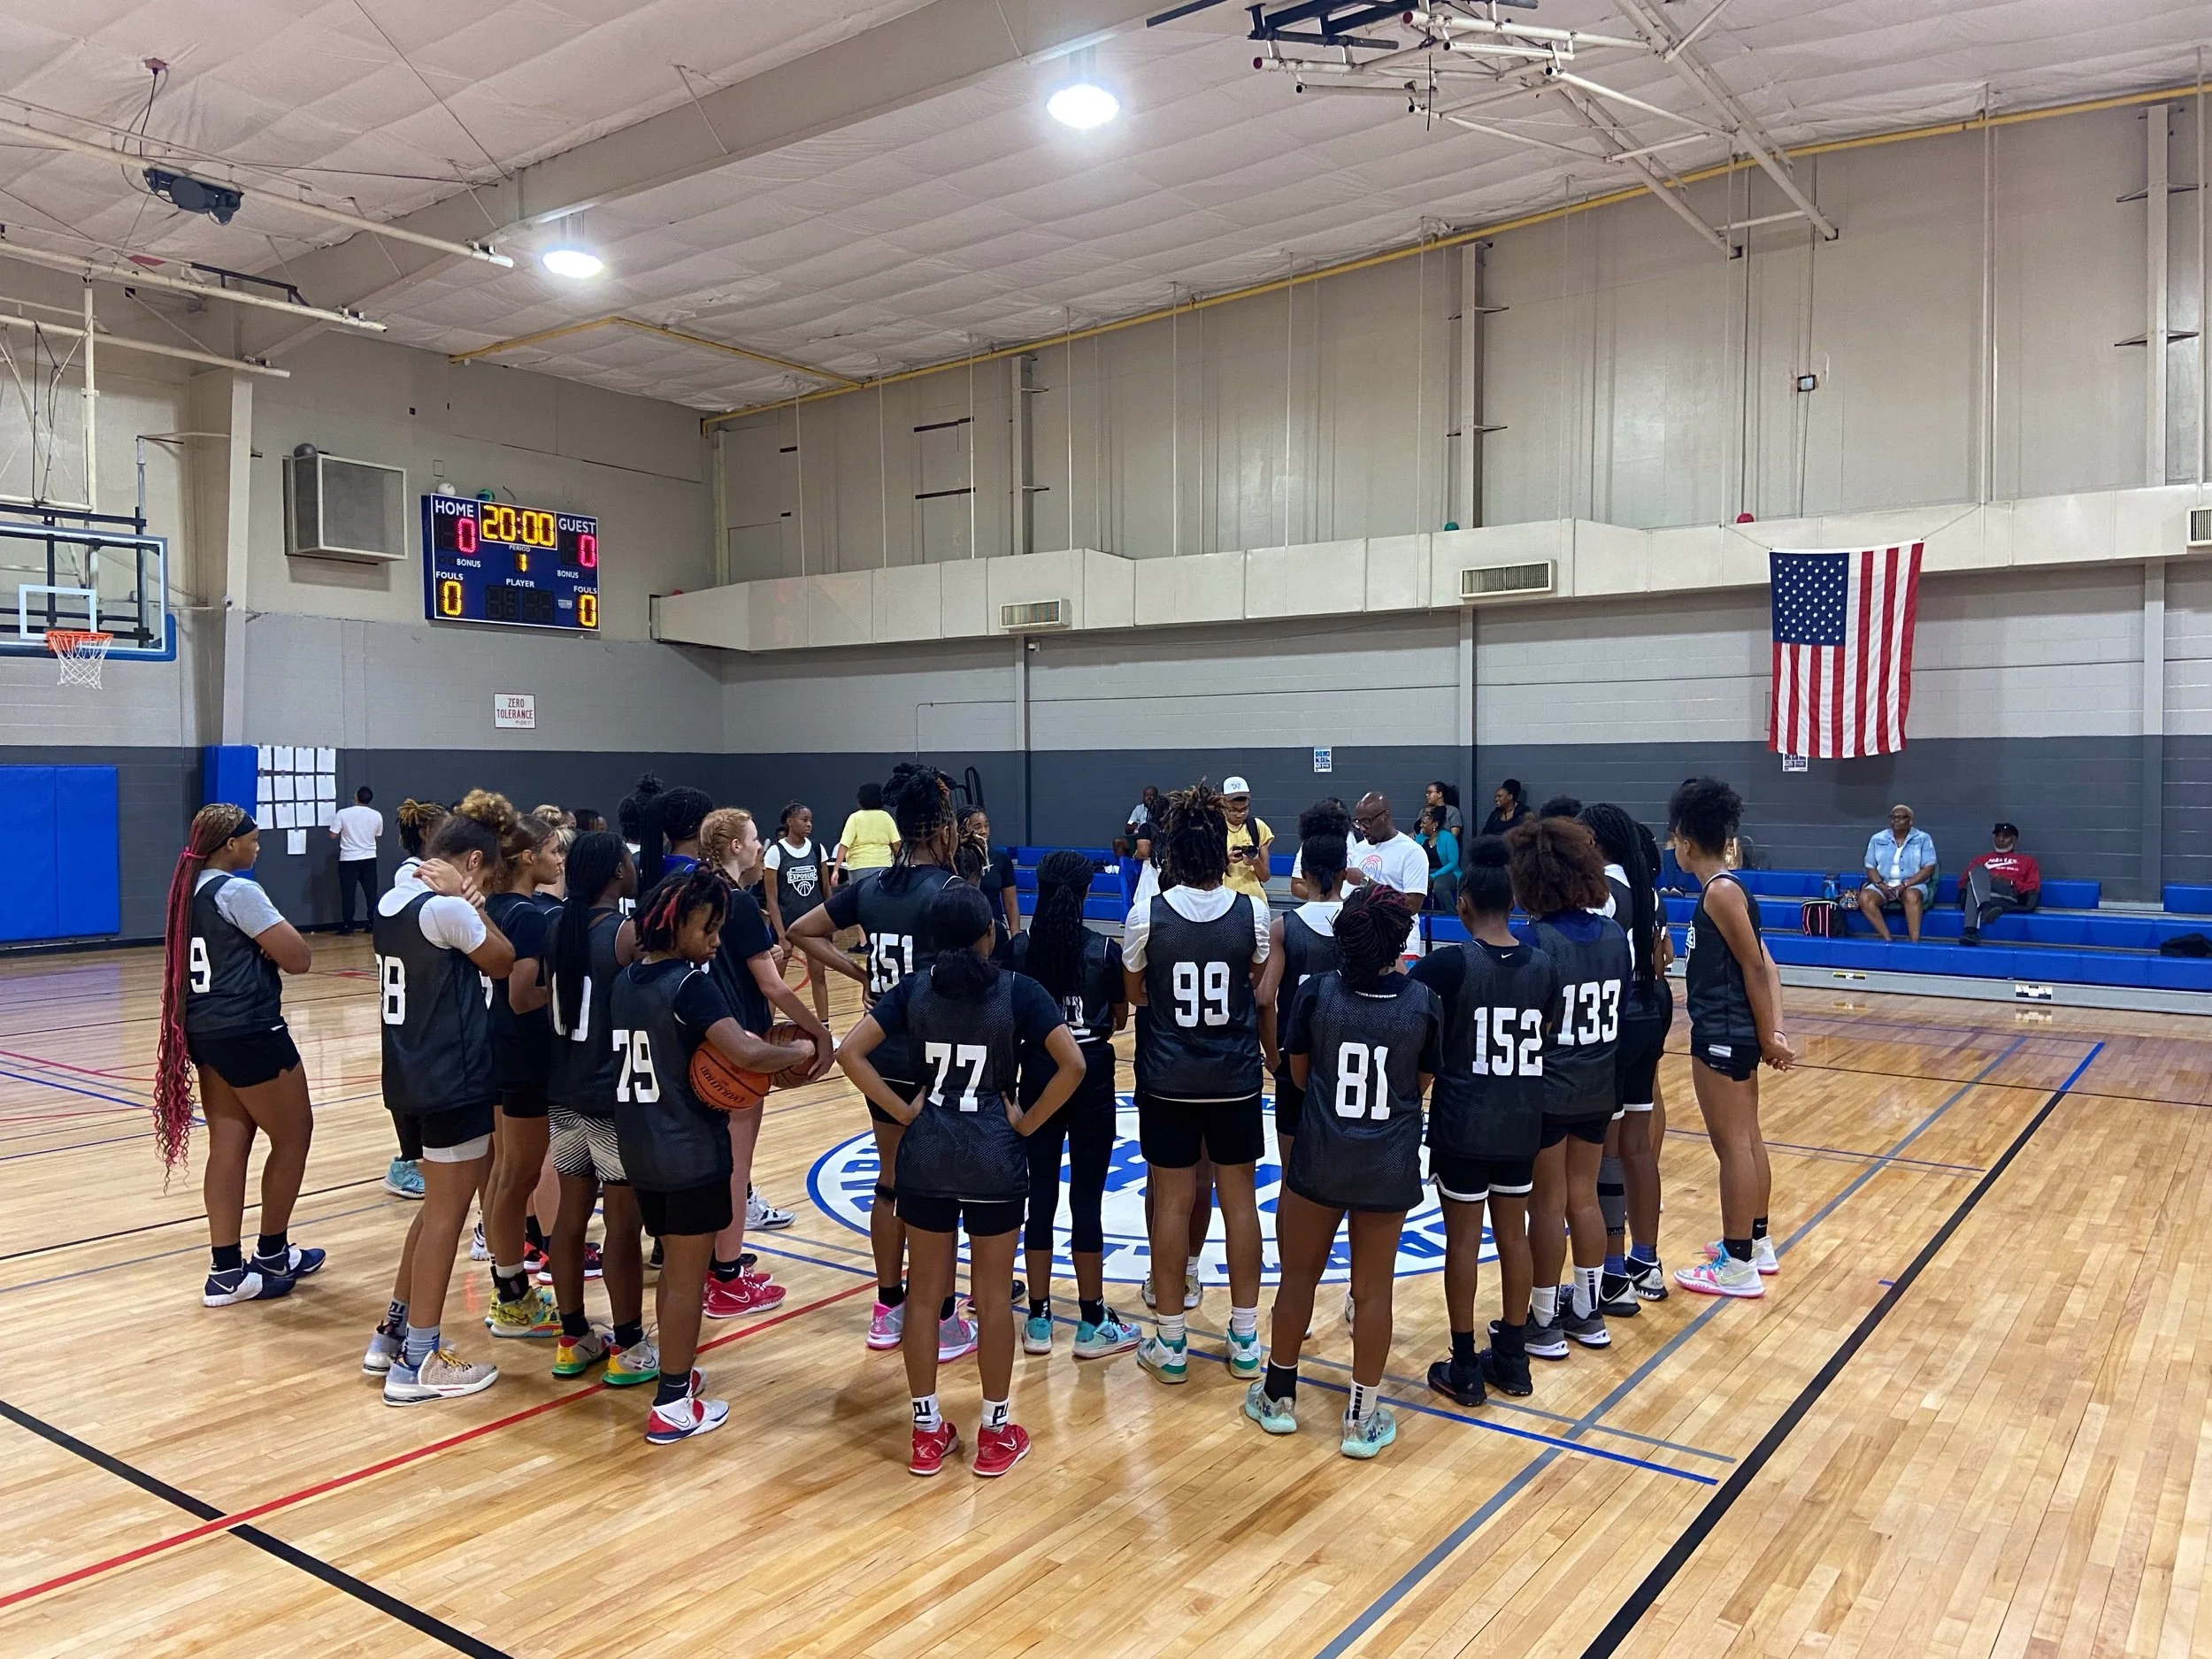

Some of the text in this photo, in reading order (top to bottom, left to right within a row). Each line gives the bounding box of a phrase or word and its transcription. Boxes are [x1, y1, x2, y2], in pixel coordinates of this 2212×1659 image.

[434, 499, 474, 518] HOME
[457, 518, 476, 553] 0
[482, 504, 555, 547] 20:00
[558, 518, 596, 534] GUEST
[456, 557, 481, 568] BONUS
[509, 544, 531, 553] PERIOD
[580, 534, 596, 568] 0
[435, 571, 464, 580] FOULS
[505, 578, 535, 588] PLAYER
[557, 570, 580, 579] BONUS
[573, 585, 598, 595] FOULS
[443, 580, 462, 616] 0
[579, 595, 597, 627] 0
[496, 709, 534, 719] TOLERANCE
[508, 698, 525, 708] ZERO
[788, 870, 818, 882] EXPOSURE
[870, 933, 913, 993] 151
[1172, 961, 1231, 1028] 99
[1557, 979, 1622, 1046] 133
[1471, 1006, 1543, 1077] 152
[612, 1029, 661, 1103] 79
[925, 1041, 987, 1112] 77
[1335, 1041, 1391, 1120] 81
